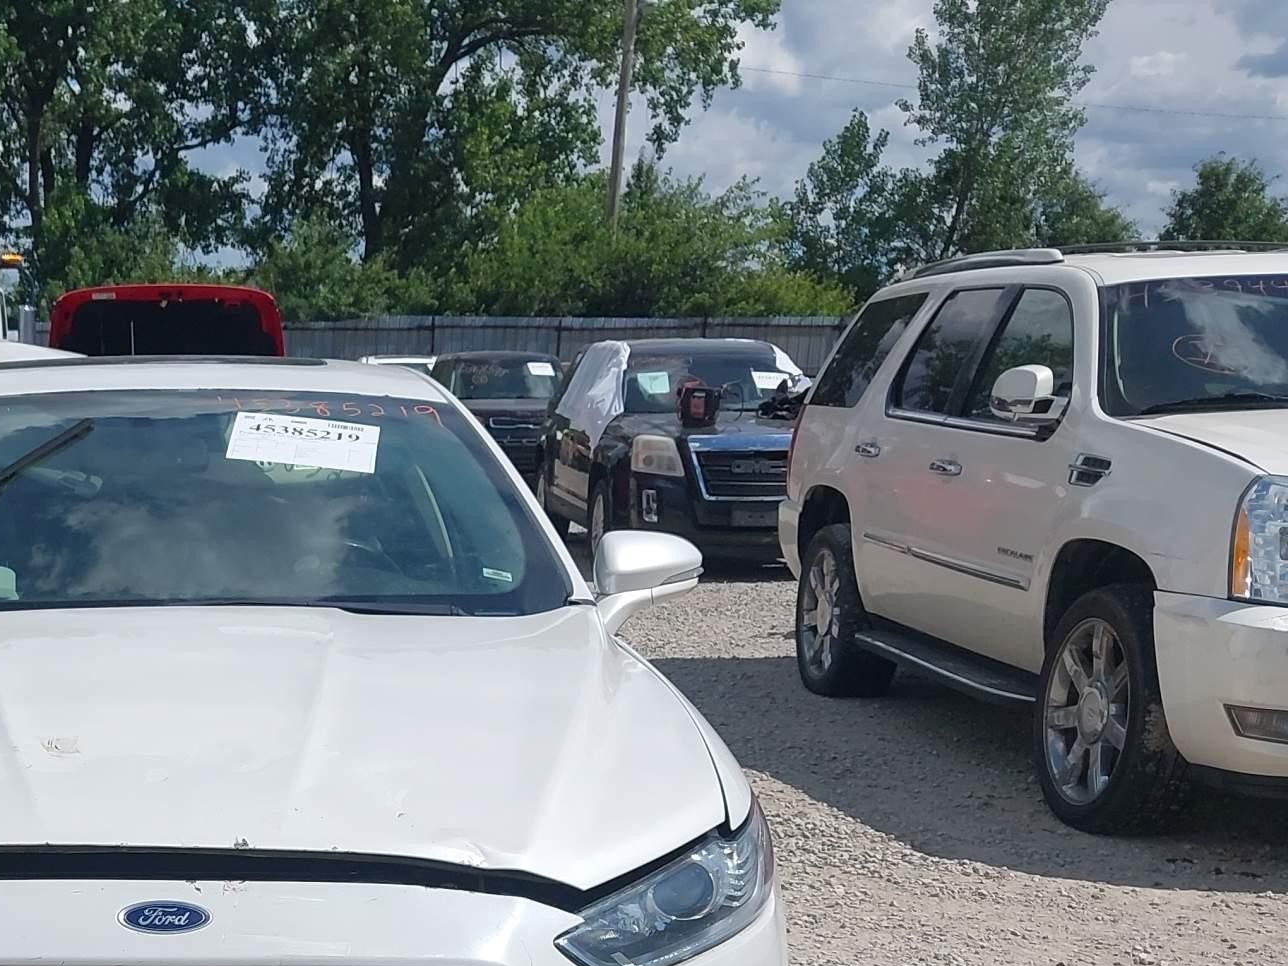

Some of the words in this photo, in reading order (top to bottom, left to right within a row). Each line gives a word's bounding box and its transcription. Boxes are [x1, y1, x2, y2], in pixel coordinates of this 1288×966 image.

[248, 423, 361, 443] 45385219
[731, 460, 787, 473] GMC
[138, 907, 191, 926] Ford
